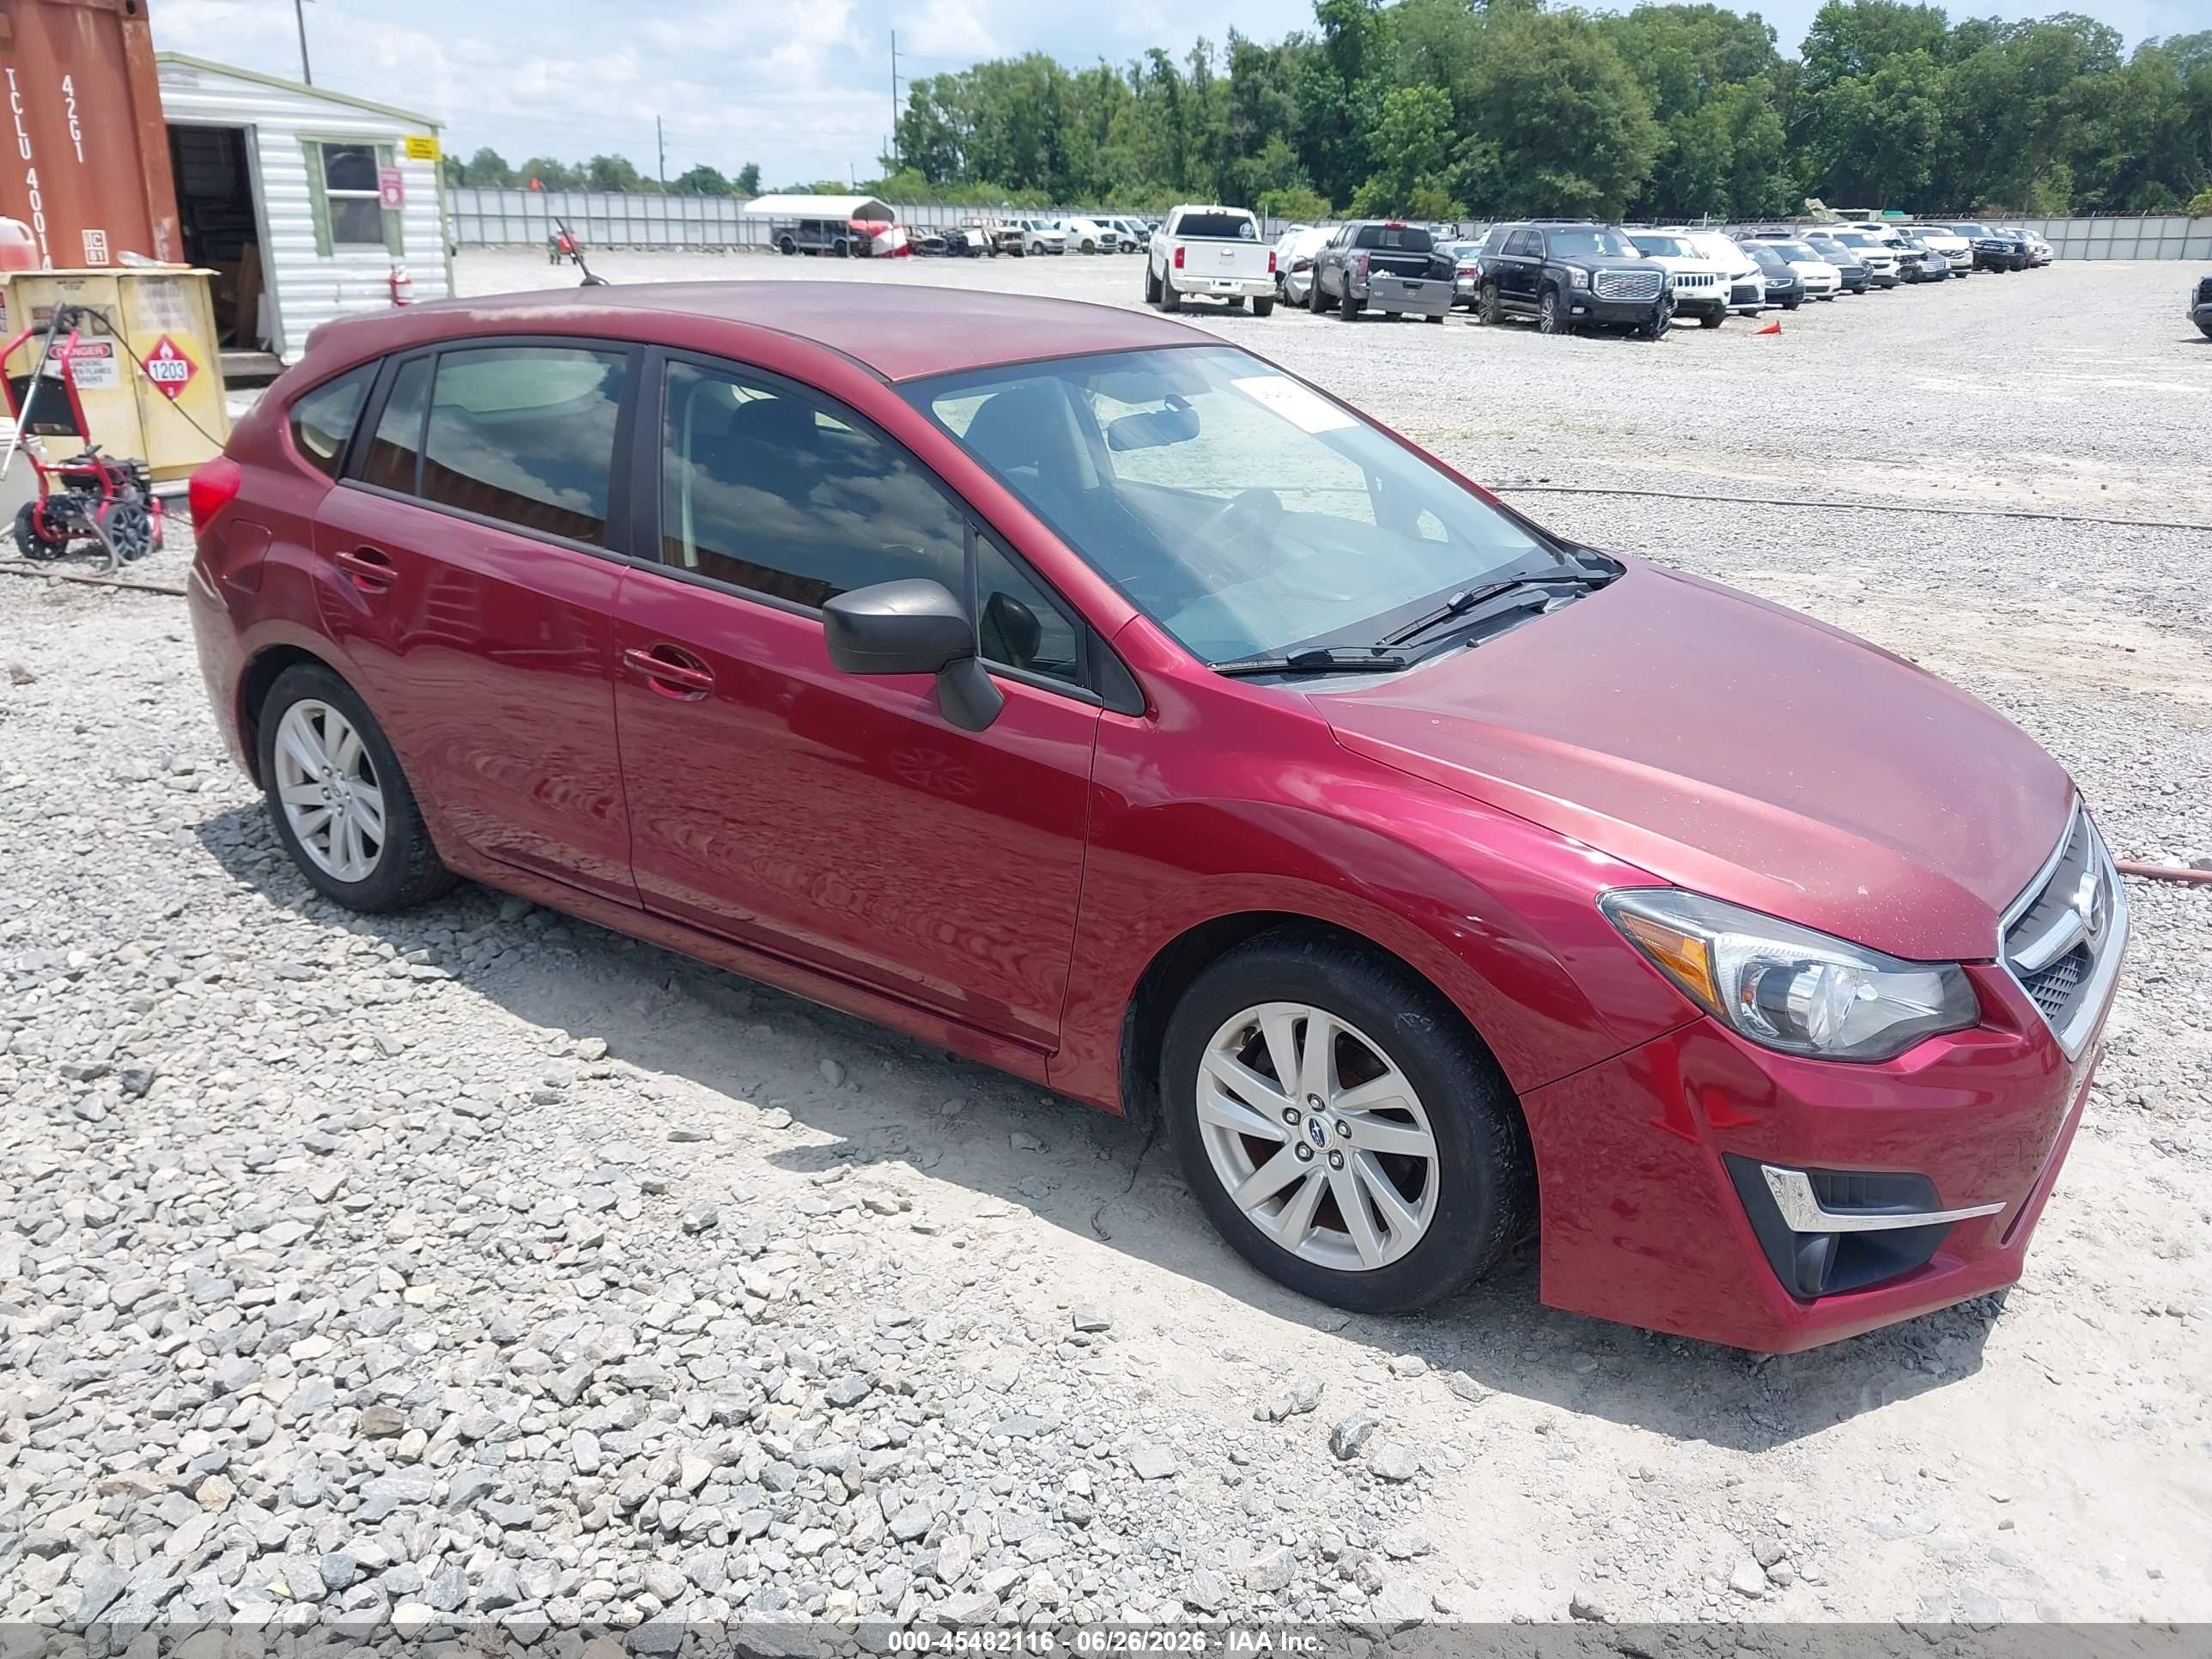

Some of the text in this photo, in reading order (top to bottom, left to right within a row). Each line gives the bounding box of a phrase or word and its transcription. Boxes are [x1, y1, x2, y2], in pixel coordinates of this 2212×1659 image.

[4, 68, 32, 160] TCLU
[61, 74, 84, 164] 42G1
[56, 345, 104, 357] DNGER
[151, 362, 185, 380] 1203
